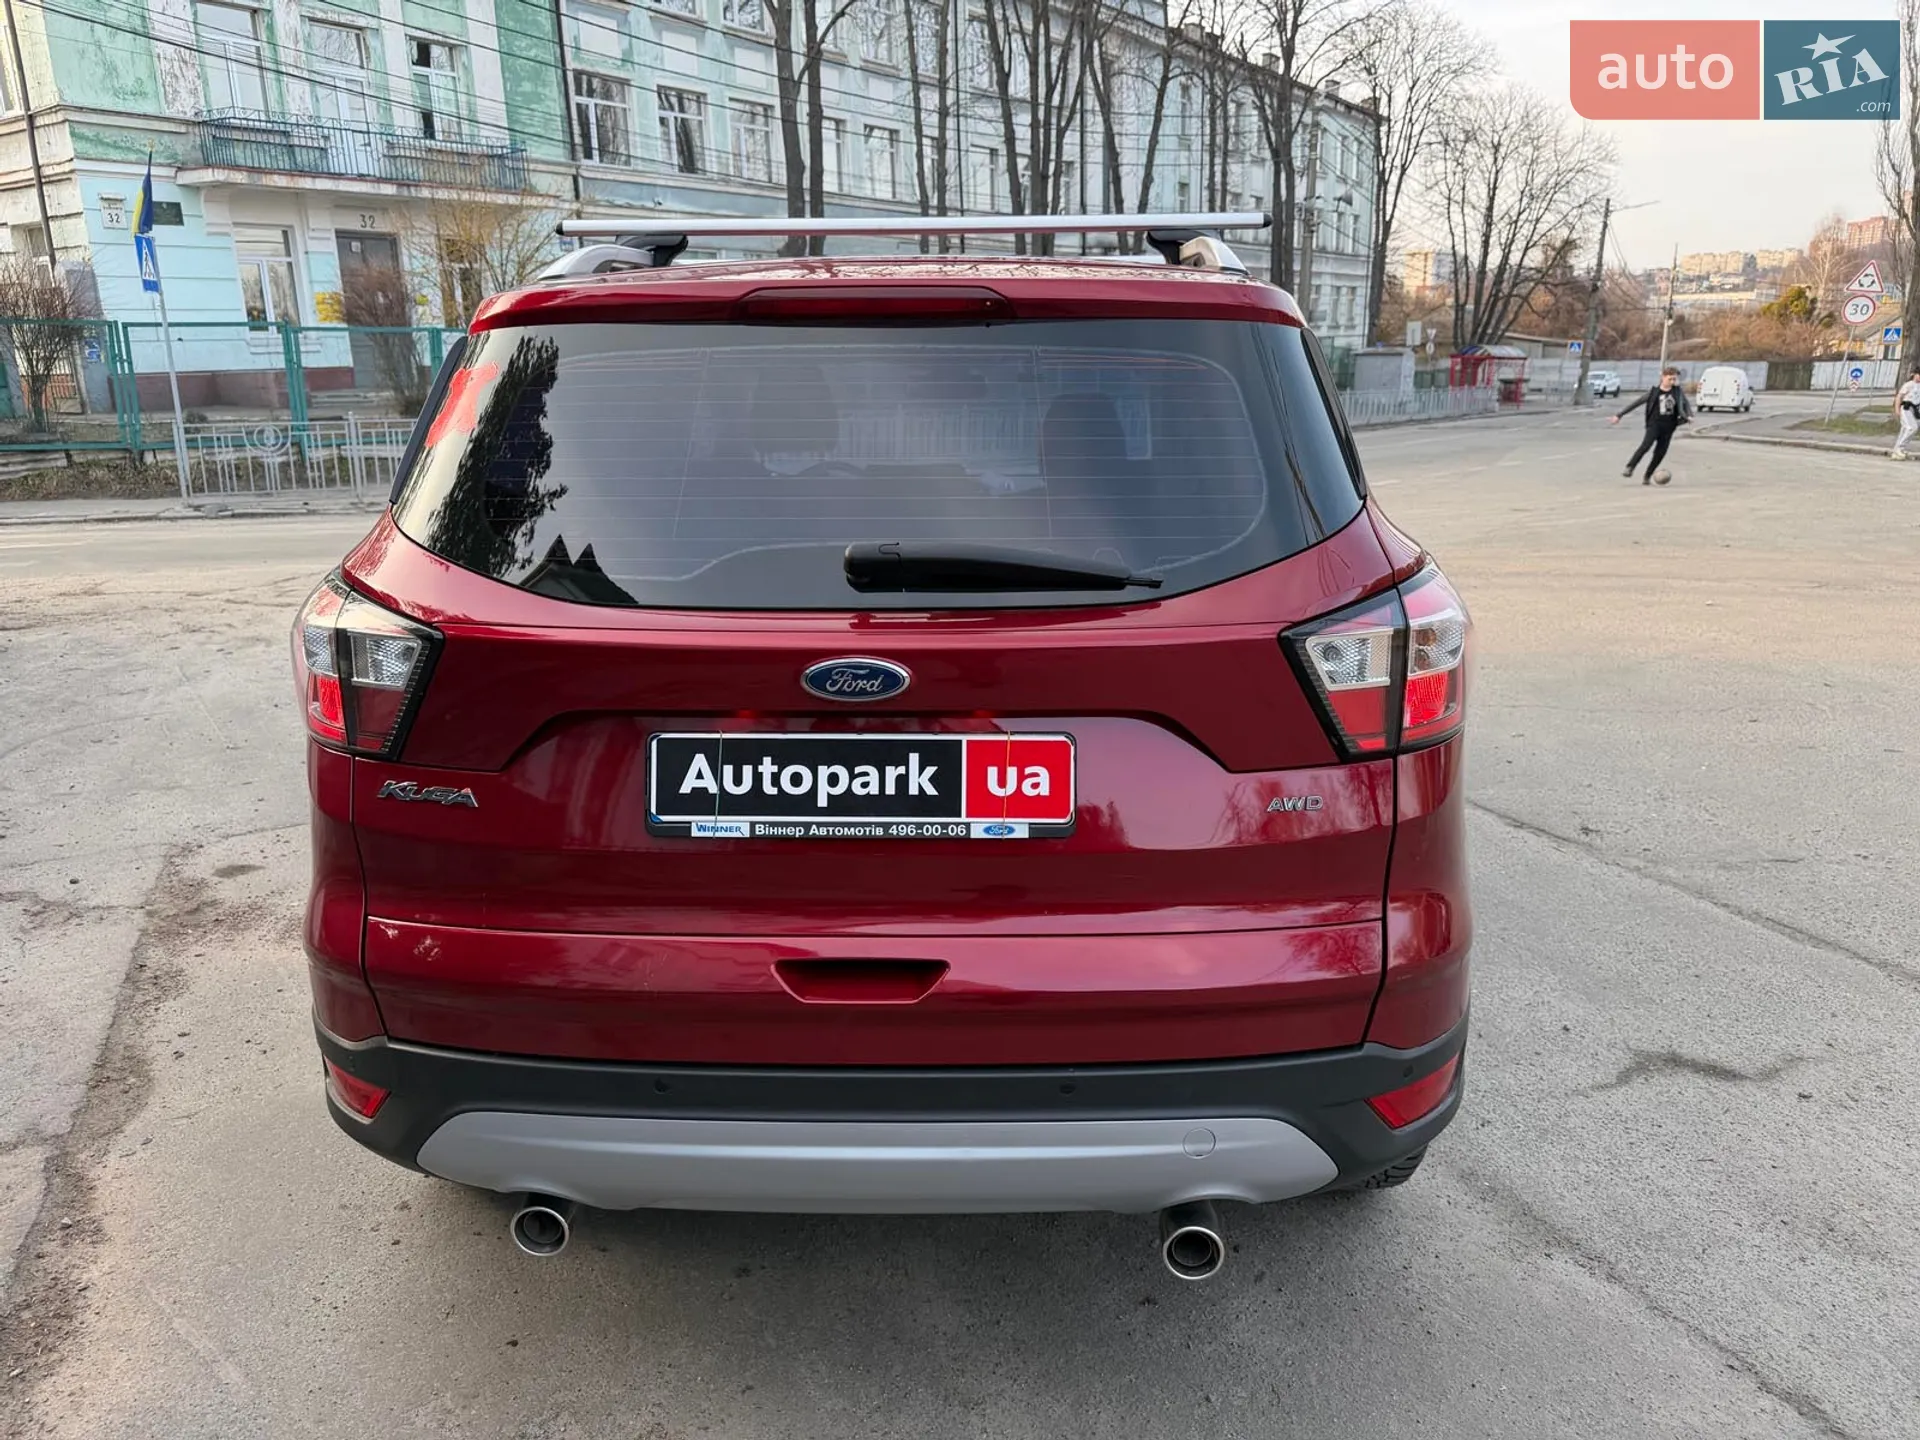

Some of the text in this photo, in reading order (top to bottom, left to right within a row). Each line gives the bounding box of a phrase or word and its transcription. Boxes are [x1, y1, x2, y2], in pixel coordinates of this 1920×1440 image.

[107, 212, 121, 224] 32
[360, 214, 376, 229] 32
[1849, 303, 1870, 316] 30
[825, 667, 885, 692] Ford
[678, 752, 1051, 808] Autopark ua
[377, 780, 479, 808] KUGA
[1267, 796, 1323, 812] AWD
[695, 822, 745, 837] WINNER
[755, 824, 967, 838] Віннер Автомотів 496-00-06
